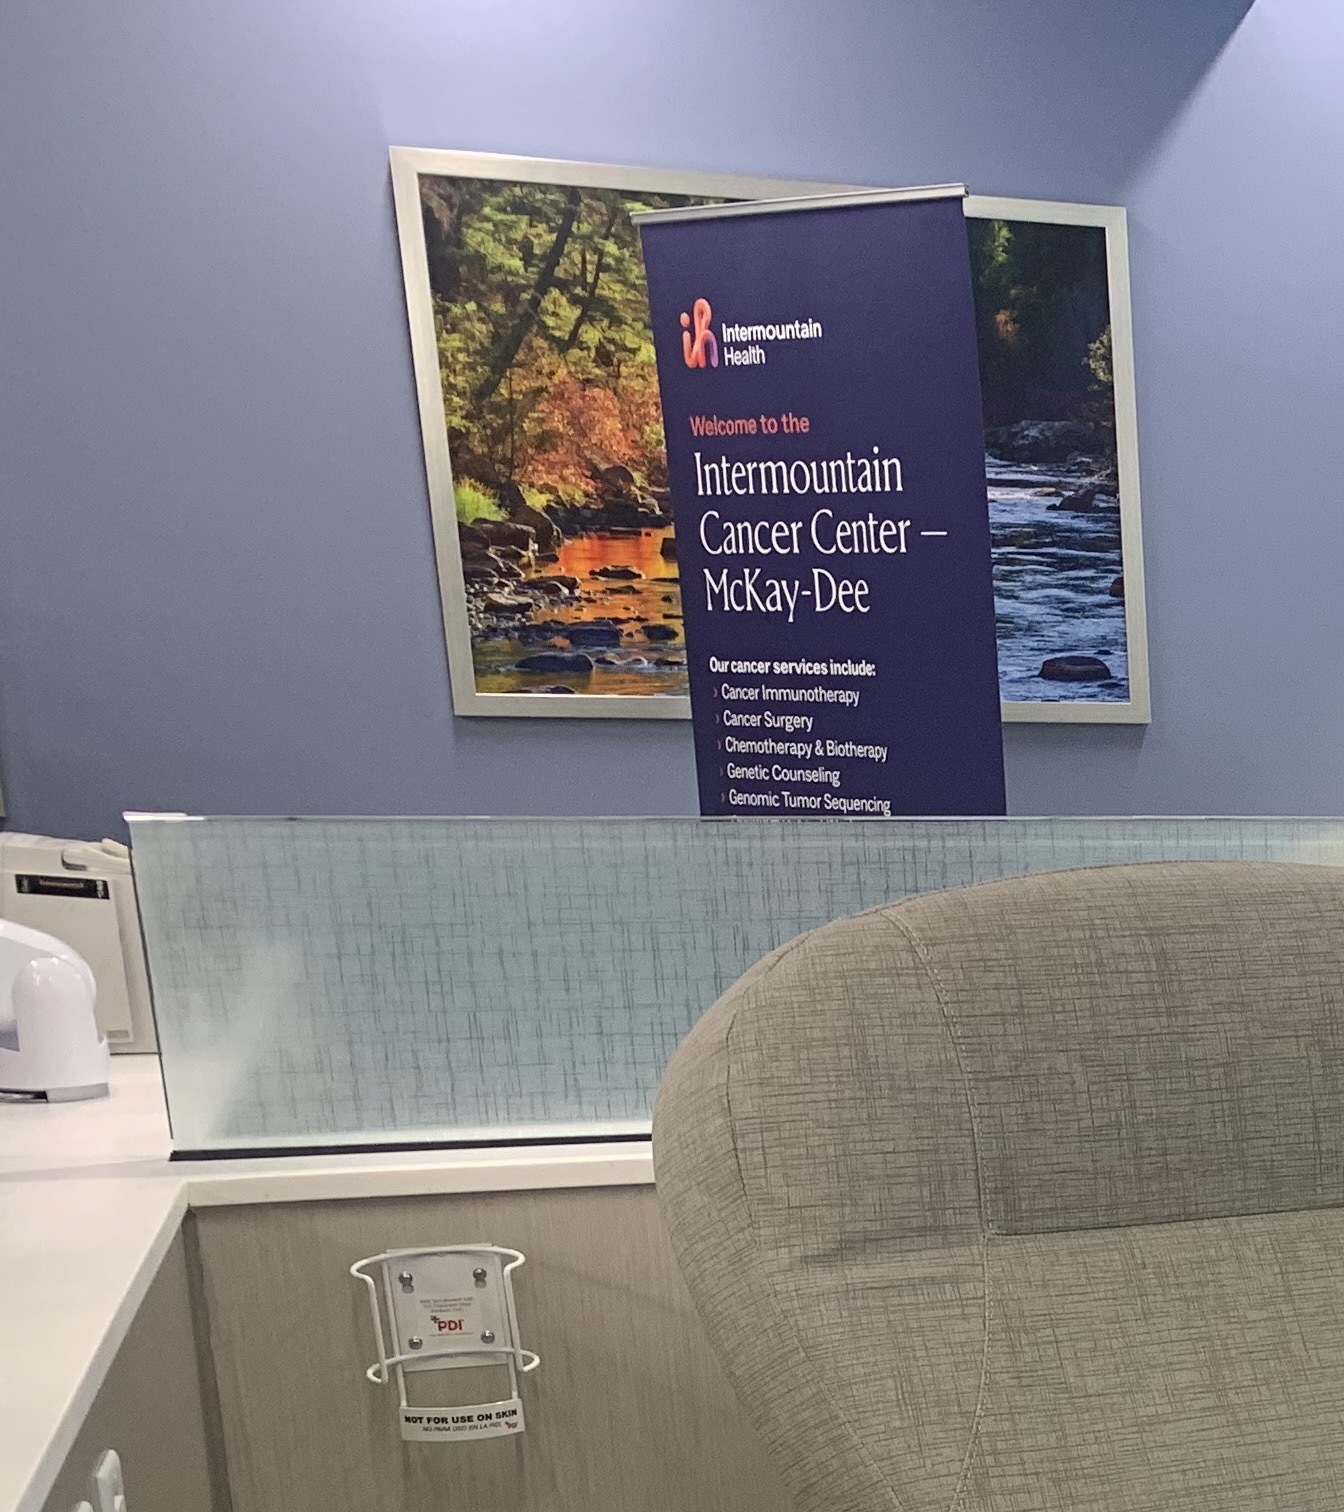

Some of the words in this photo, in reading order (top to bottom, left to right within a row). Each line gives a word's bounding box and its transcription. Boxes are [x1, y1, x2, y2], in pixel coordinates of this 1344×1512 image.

[722, 318, 822, 343] Intermountain
[724, 344, 766, 367] Health
[690, 415, 757, 436] Welcome
[760, 414, 778, 434] to
[781, 412, 810, 433] the
[694, 446, 904, 496] Intermountain
[700, 509, 803, 556] Cancer
[811, 507, 911, 555] Center
[703, 567, 870, 622] McKay-Dee
[709, 656, 729, 673] Our
[731, 659, 770, 674] cancer
[773, 658, 828, 676] services
[830, 659, 876, 676] include:
[721, 683, 759, 700] Cancer
[762, 684, 860, 707] Immunotherapy
[723, 710, 761, 727] Cancer
[764, 711, 813, 732] Surgery
[725, 736, 812, 759] Chemotherapy
[815, 740, 824, 756] &
[826, 740, 887, 762] Biotherapy
[727, 763, 769, 781] Genetic
[772, 765, 840, 787] Counseling
[729, 789, 779, 807] Genomic
[782, 791, 821, 809] Tumor
[824, 793, 891, 816] Sequencing
[438, 1319, 462, 1331] PDI
[404, 1415, 424, 1424] NOT
[426, 1416, 449, 1425] FOR
[452, 1415, 474, 1424] USE
[477, 1413, 492, 1422] ON
[495, 1409, 517, 1420] SKIN
